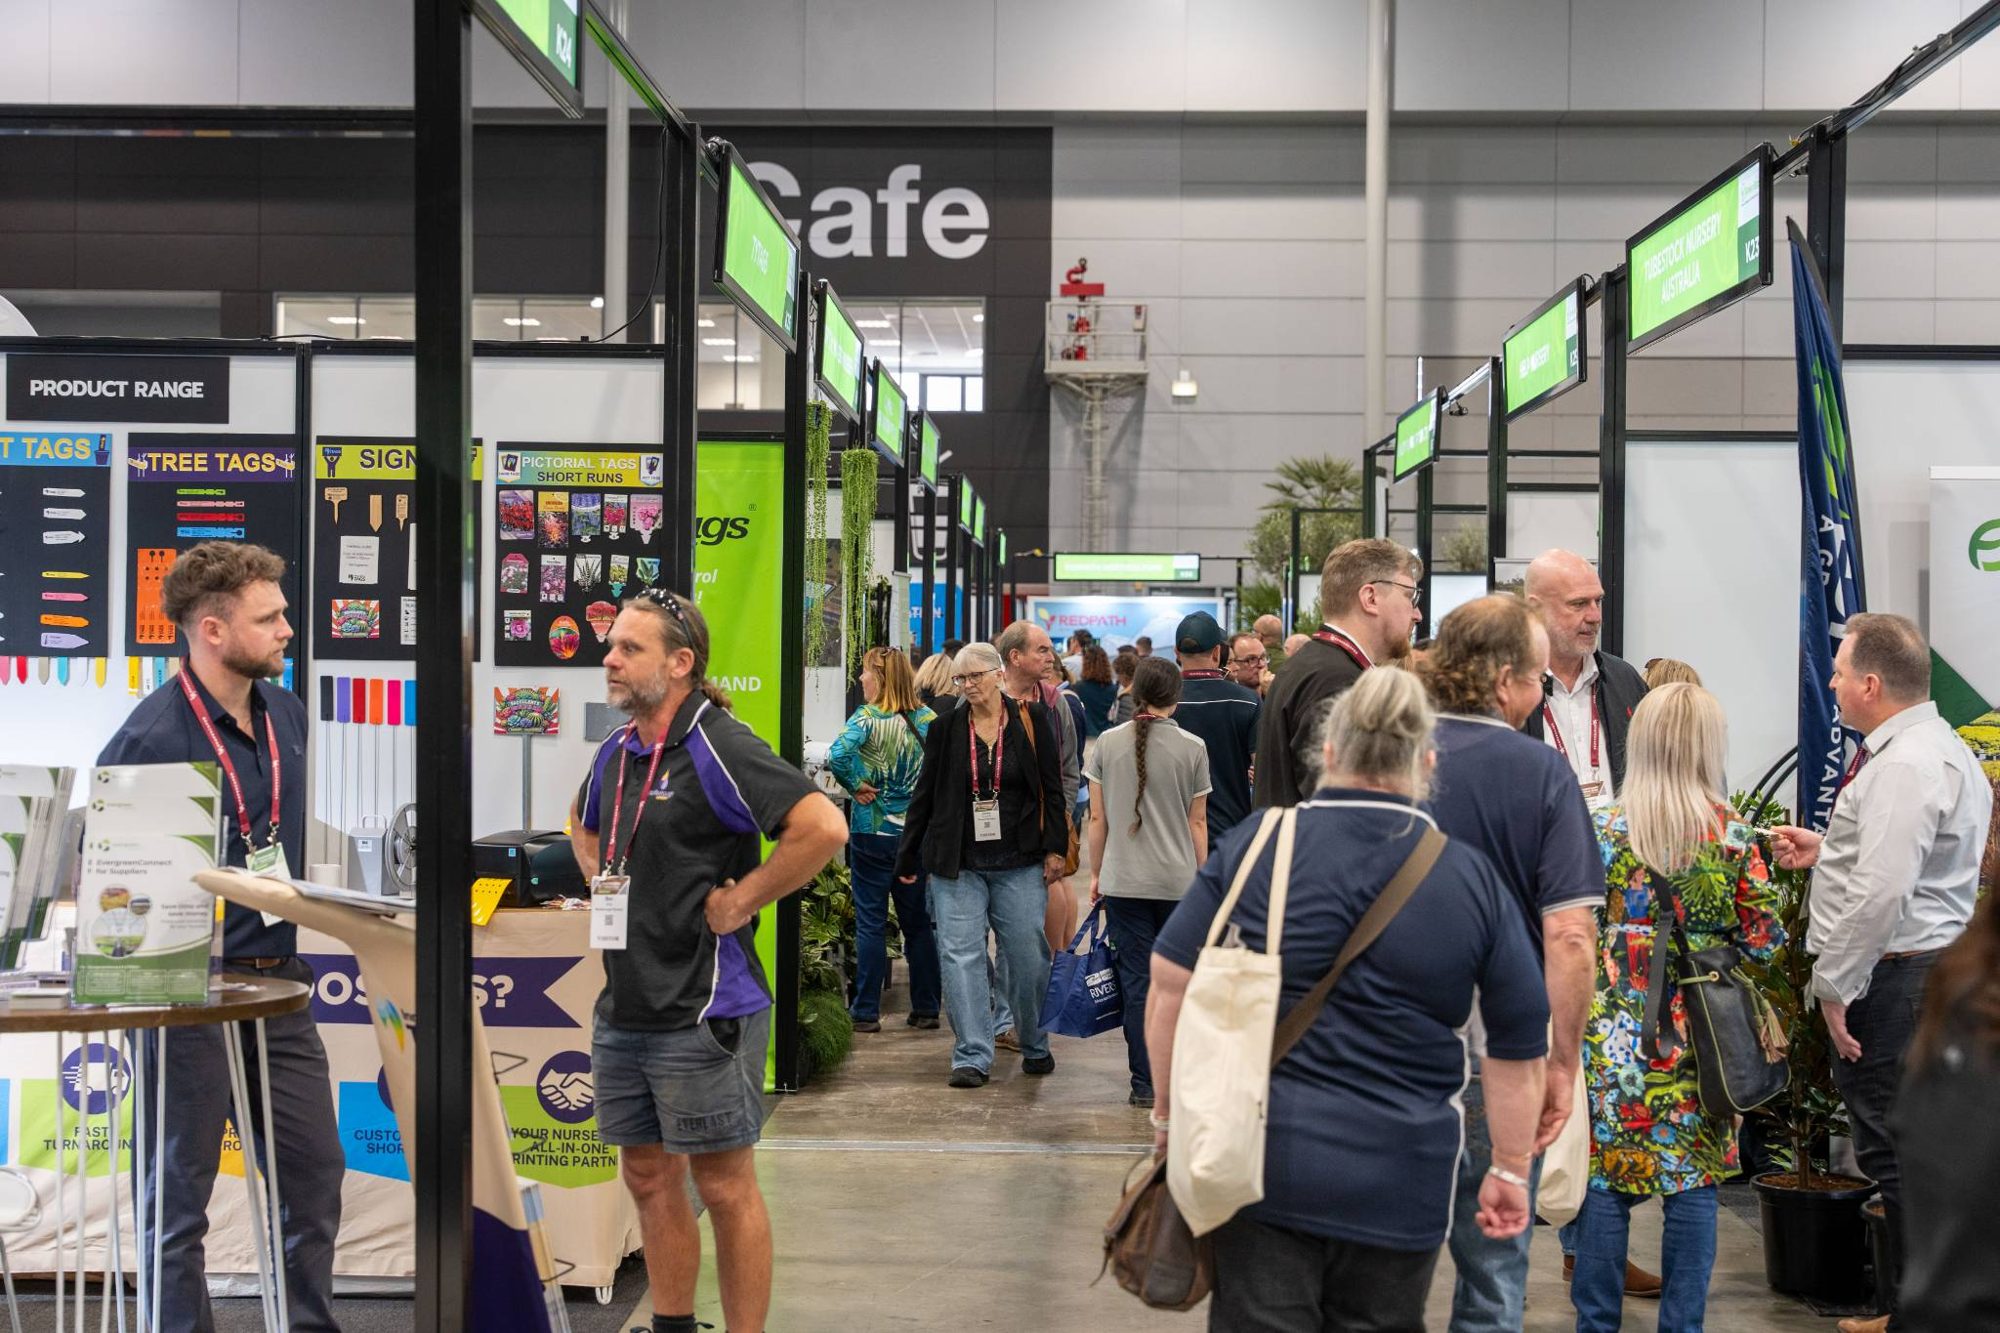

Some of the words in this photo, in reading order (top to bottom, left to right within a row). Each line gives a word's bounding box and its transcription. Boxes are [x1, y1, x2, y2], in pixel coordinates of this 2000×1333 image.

[555, 23, 572, 69] K24
[1644, 237, 1685, 282] TUBESTOCK
[1686, 211, 1722, 255] NURSERY
[1745, 236, 1760, 264] K23
[1660, 259, 1700, 305] AUSTRALIA
[29, 379, 128, 399] PRODUCT
[134, 381, 205, 400] RANGE
[22, 438, 92, 460] TAGS
[147, 452, 208, 472] TREE
[215, 453, 276, 473] TAGS
[522, 455, 596, 470] PICTORIAL
[599, 458, 638, 471] TAGS
[537, 471, 584, 483] SHORT
[586, 473, 624, 484] RUNS
[1058, 615, 1127, 627] REDPATH
[511, 1127, 549, 1140] YOUR
[530, 1141, 610, 1155] ALL-IN-ONE
